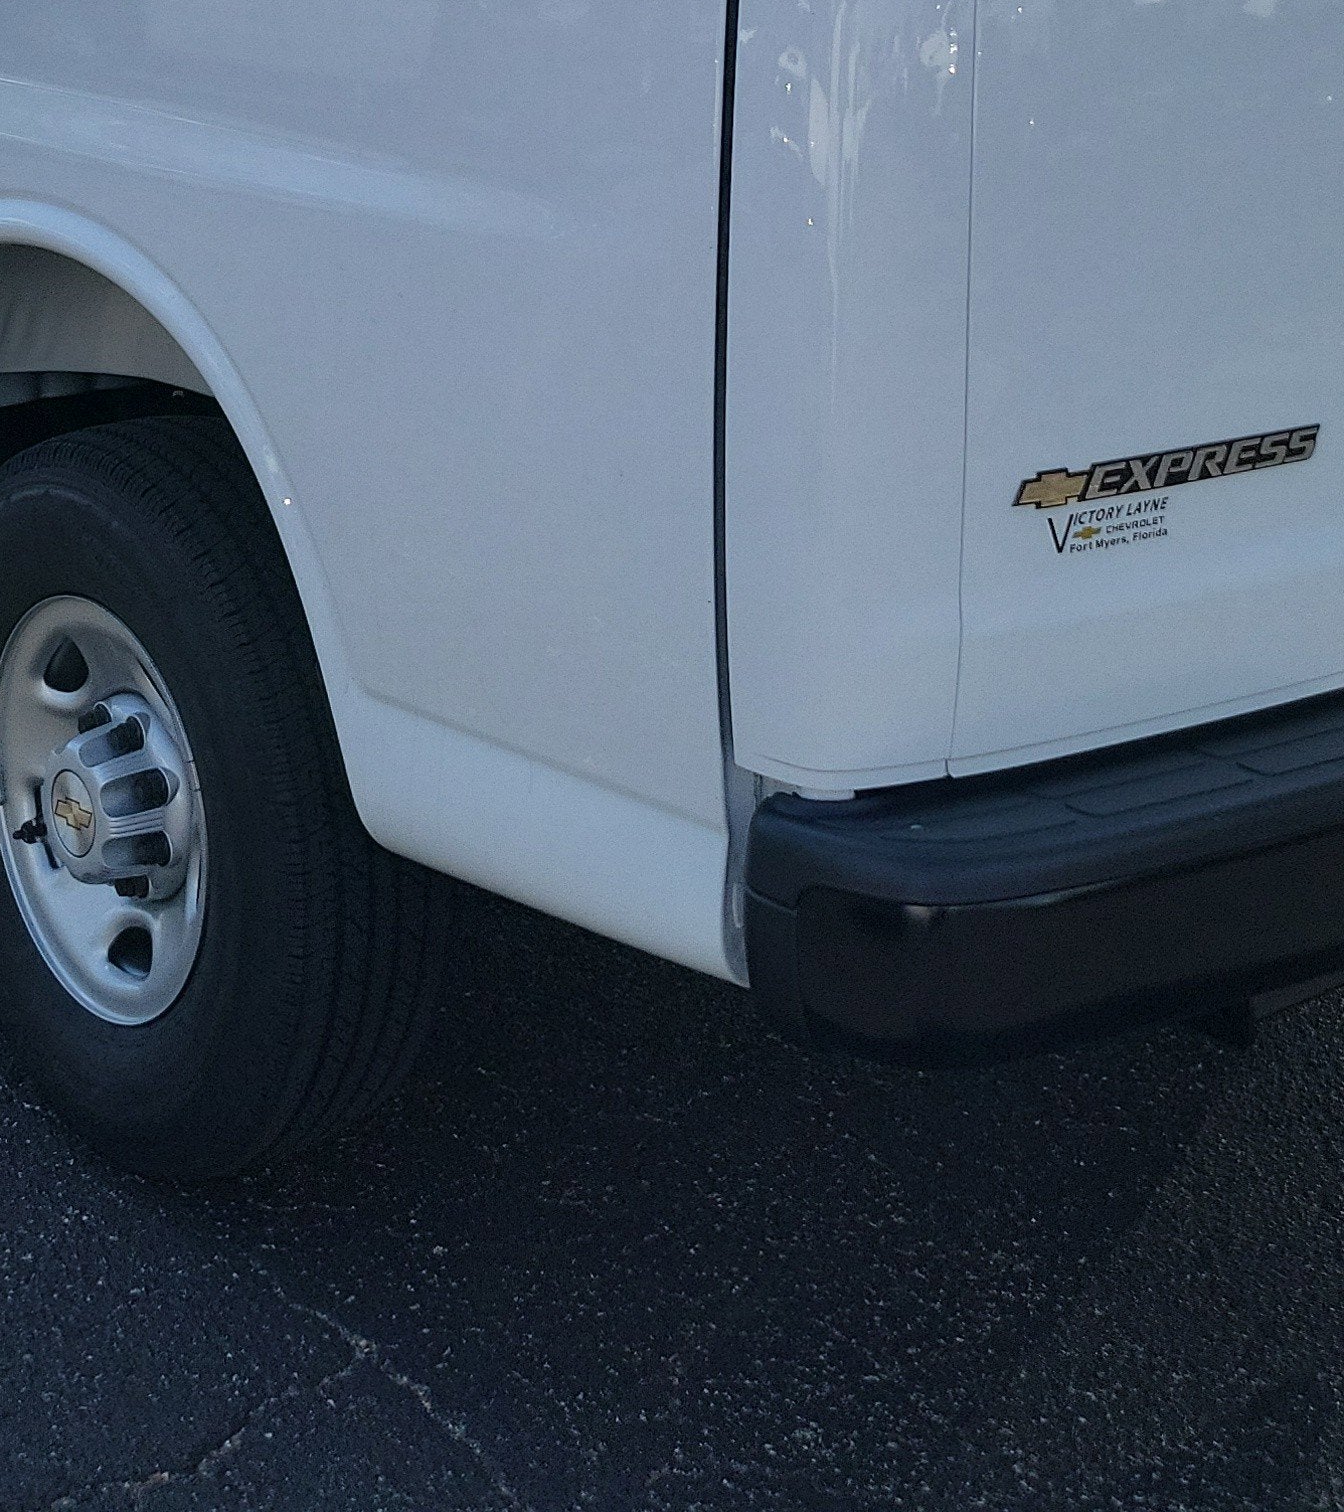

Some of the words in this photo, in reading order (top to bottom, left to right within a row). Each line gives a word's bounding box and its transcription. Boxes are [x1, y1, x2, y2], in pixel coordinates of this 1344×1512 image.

[1084, 426, 1318, 500] EXPRESS
[1047, 504, 1124, 553] VICTORY
[1126, 496, 1169, 517] LAYNE
[1069, 540, 1093, 554] Fort
[1095, 534, 1130, 550] Myers,
[1132, 527, 1168, 541] Florida
[1105, 515, 1165, 534] CHEVROLET
